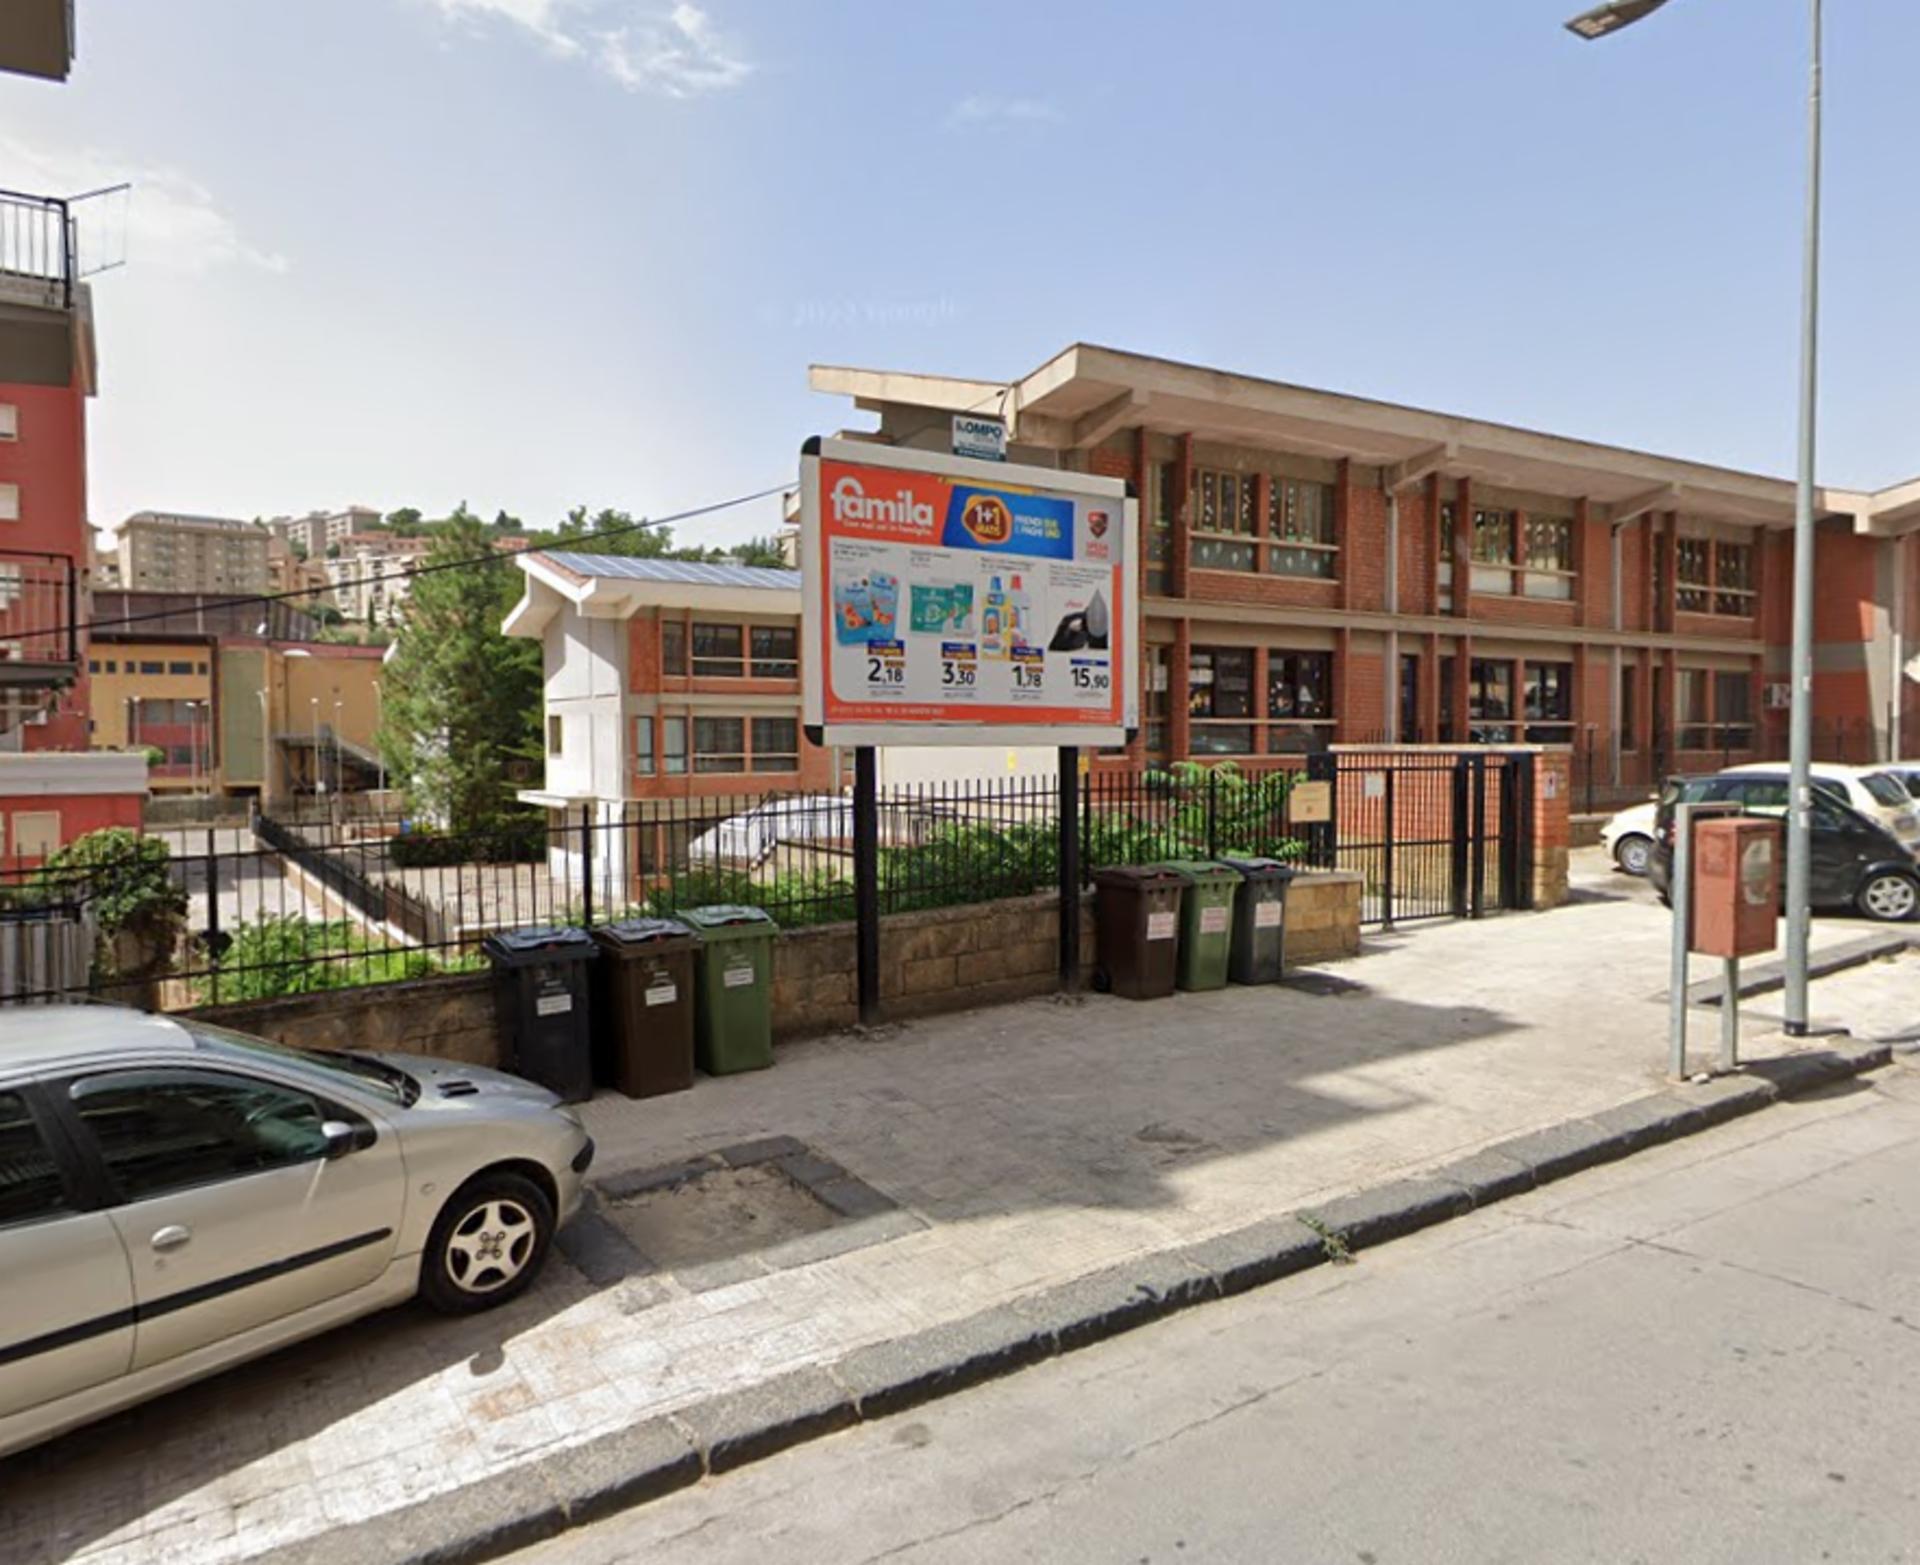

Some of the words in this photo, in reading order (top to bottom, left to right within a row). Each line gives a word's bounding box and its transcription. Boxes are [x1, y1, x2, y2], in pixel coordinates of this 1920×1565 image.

[830, 475, 934, 528] famila
[975, 503, 1000, 526] 1+1
[867, 657, 904, 684] 2,18
[941, 661, 977, 686] 3,30
[1011, 665, 1043, 688] 1,78
[1069, 667, 1110, 690] 15,90
